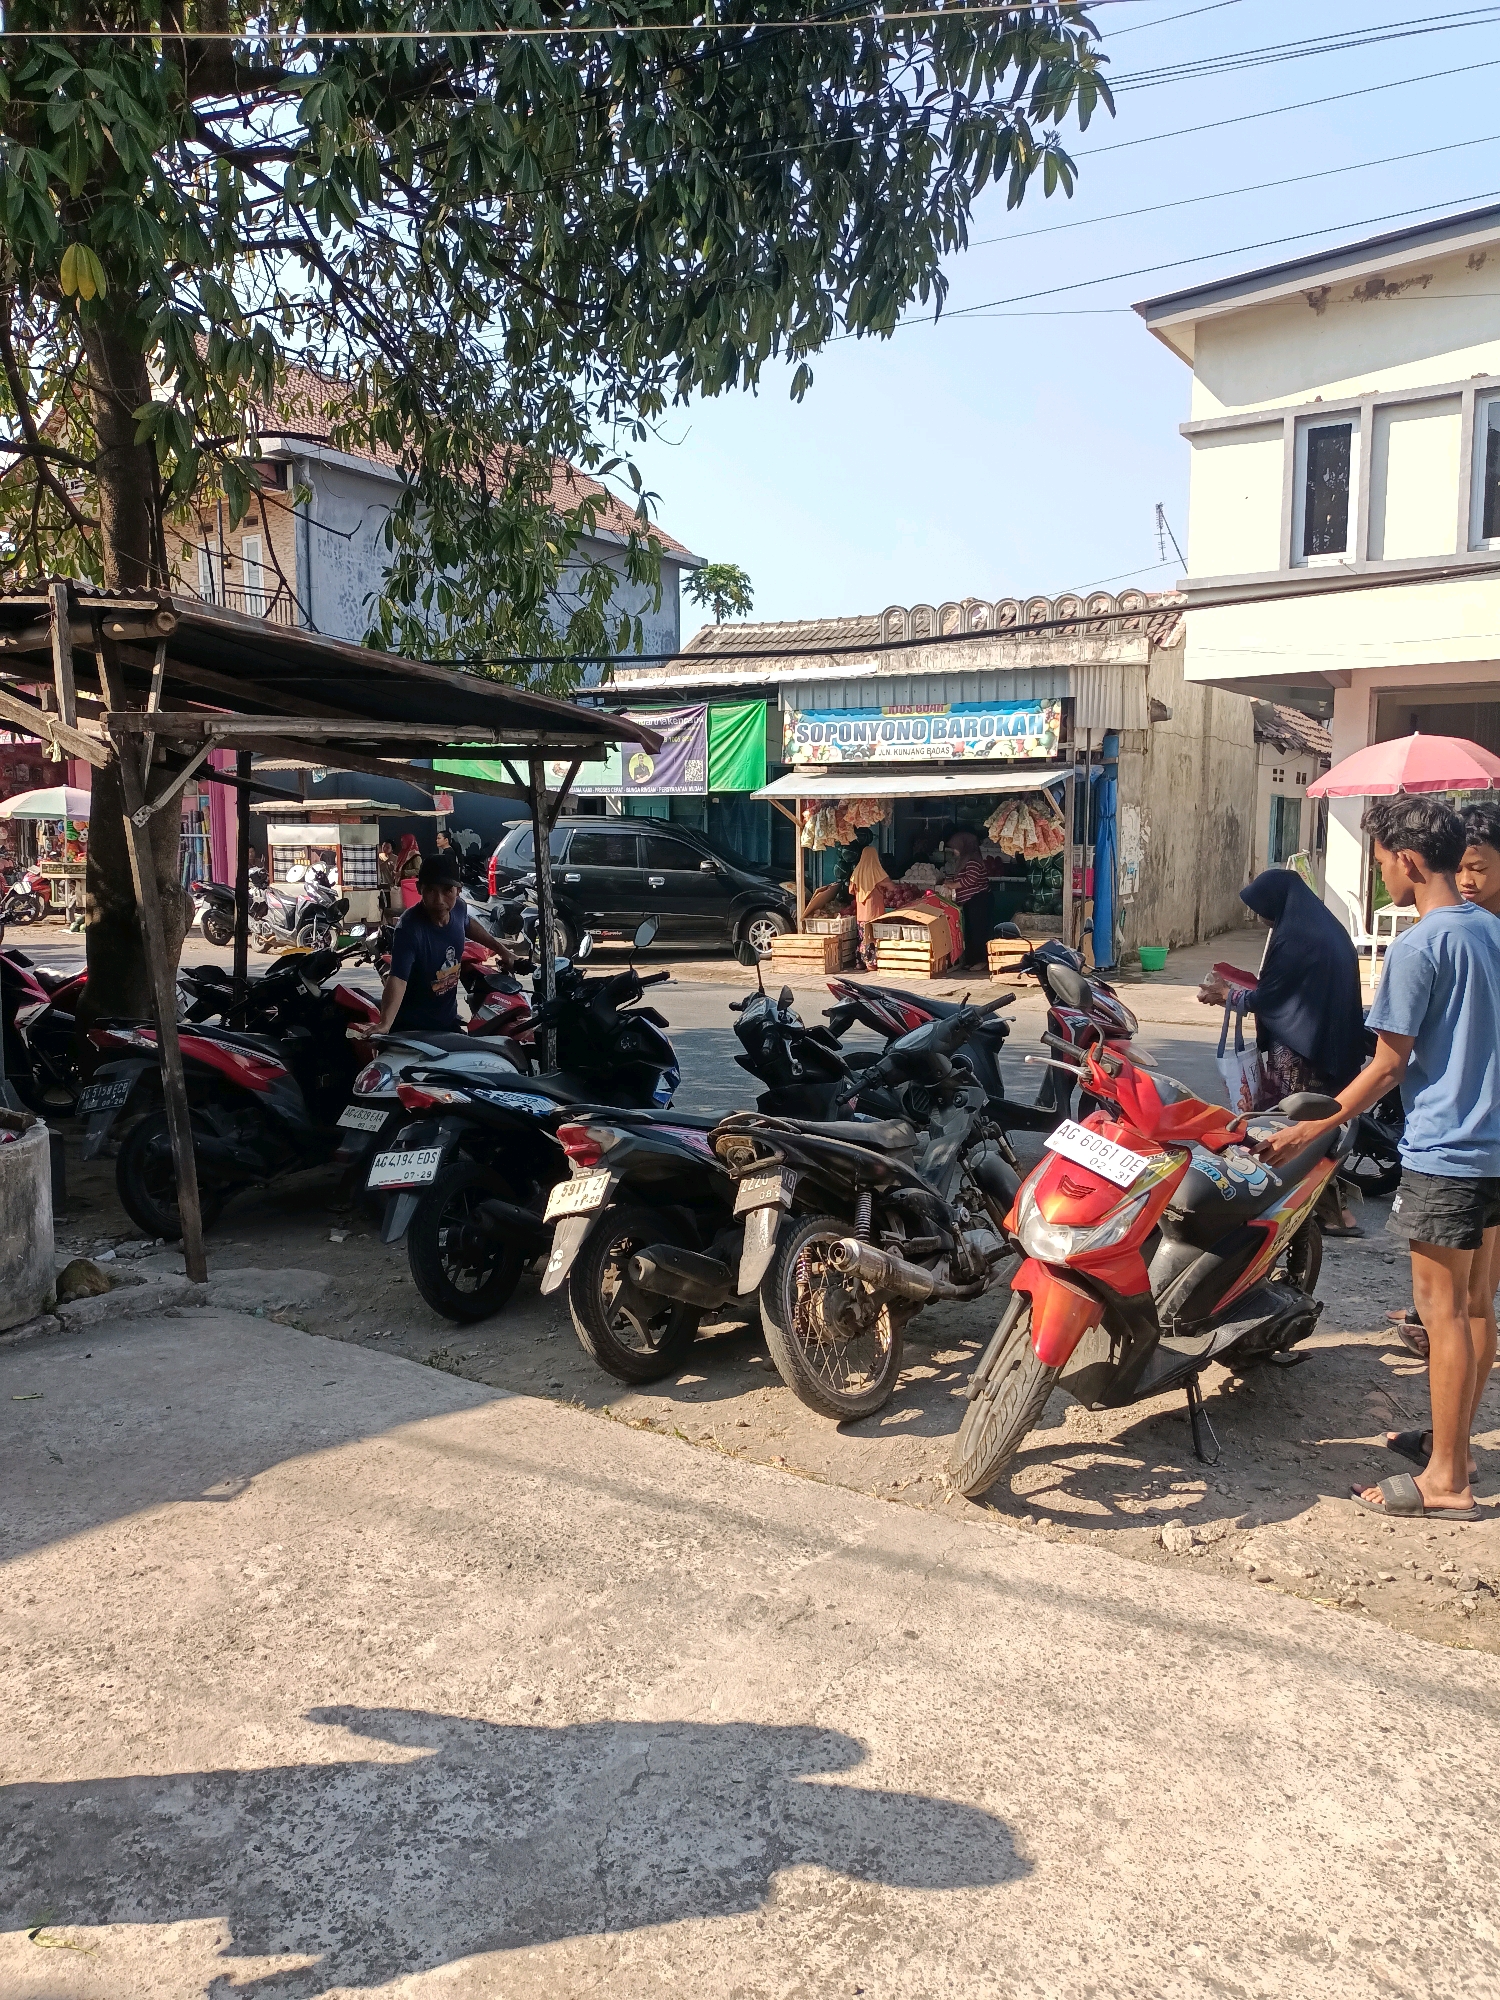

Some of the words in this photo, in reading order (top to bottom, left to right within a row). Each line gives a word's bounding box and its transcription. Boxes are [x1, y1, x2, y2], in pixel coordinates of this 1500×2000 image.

[798, 720, 927, 744] SOPONYONO
[932, 714, 1045, 740] BAROKAH
[894, 747, 925, 756] KUNJANG
[926, 746, 950, 755] BADAS
[1057, 1124, 1080, 1140] AG
[1080, 1134, 1120, 1160] 6061
[1120, 1154, 1145, 1173] DE
[374, 1155, 389, 1168] AG
[388, 1153, 415, 1168] 4194
